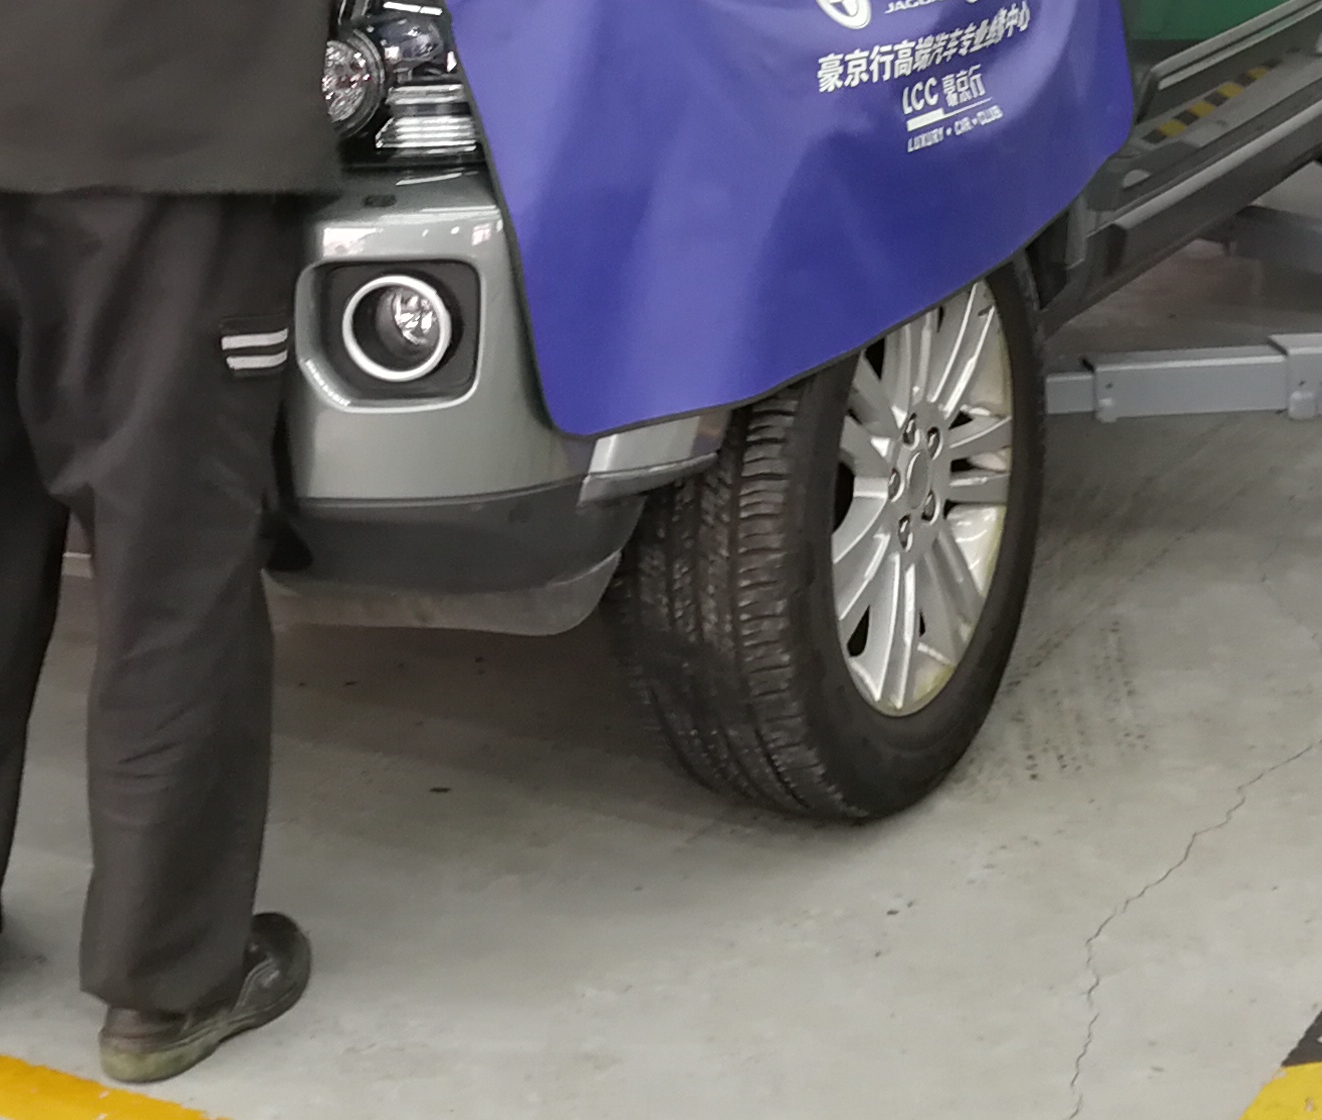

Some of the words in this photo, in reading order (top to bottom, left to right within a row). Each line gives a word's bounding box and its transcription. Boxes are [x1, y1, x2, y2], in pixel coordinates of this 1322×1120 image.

[902, 76, 939, 115] LCC
[941, 63, 986, 108] 豪京行
[906, 126, 945, 153] LUXURY
